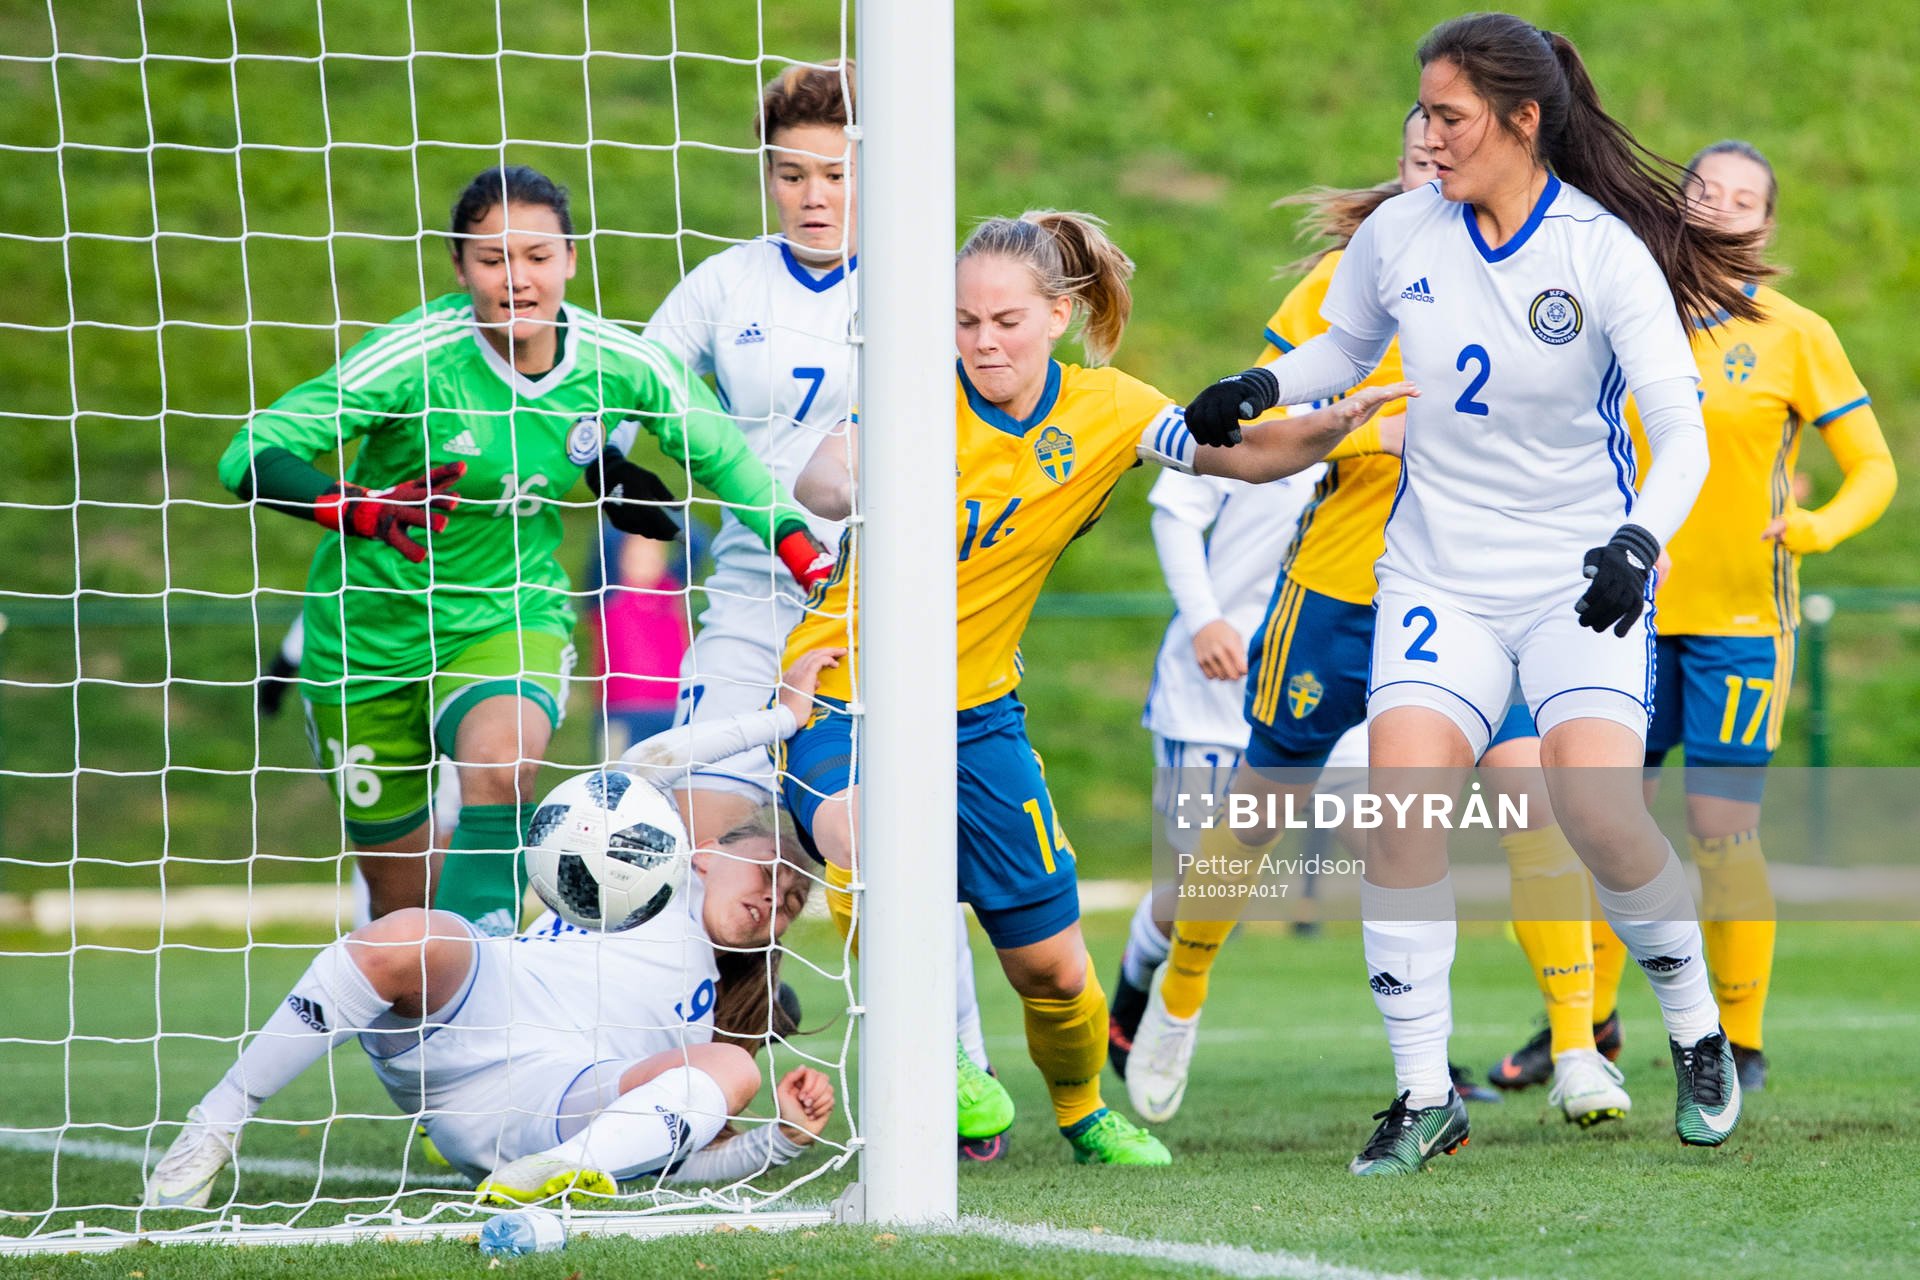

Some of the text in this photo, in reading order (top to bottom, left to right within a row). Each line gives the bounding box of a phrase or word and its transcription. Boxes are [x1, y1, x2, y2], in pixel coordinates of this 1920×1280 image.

[1400, 291, 1435, 304] adidas
[1534, 328, 1577, 344] KAZAKHSTAN
[792, 367, 825, 427] 7
[1455, 344, 1491, 416] 2
[493, 473, 548, 517] 16
[1402, 605, 1438, 663] 2
[1719, 674, 1774, 746] 17
[326, 736, 382, 808] 16
